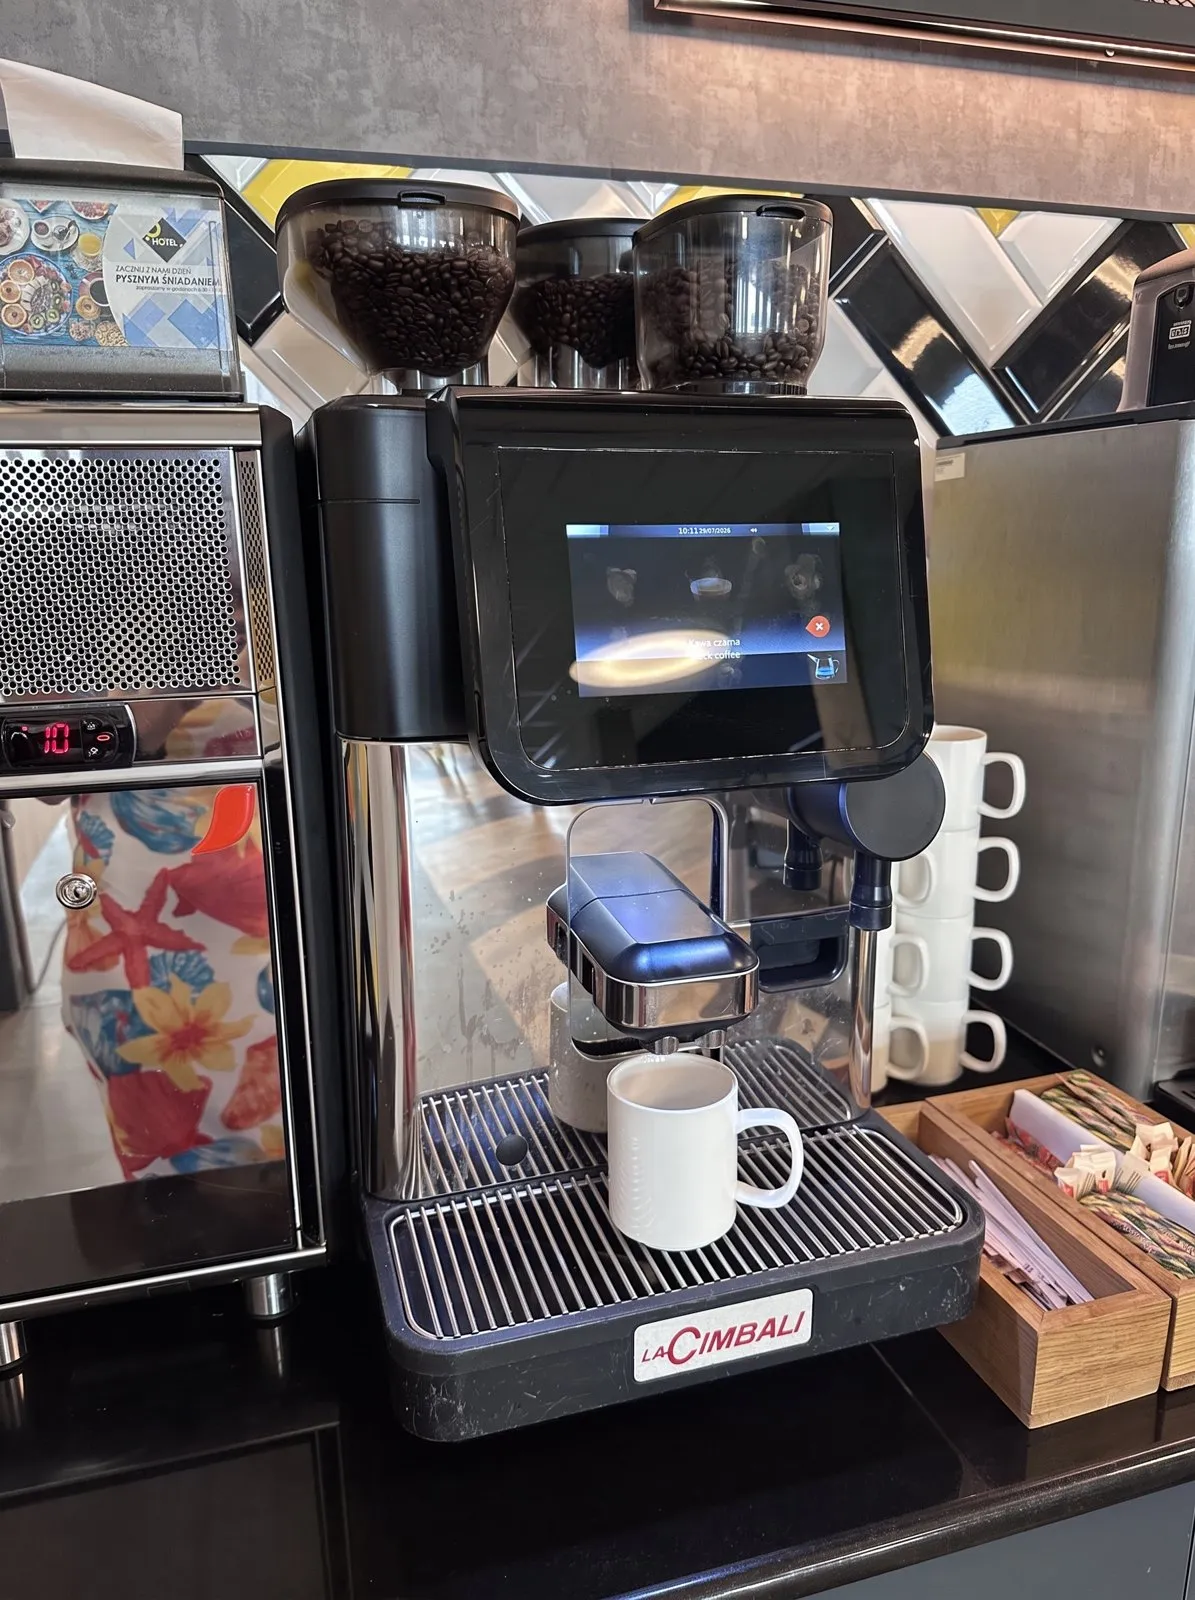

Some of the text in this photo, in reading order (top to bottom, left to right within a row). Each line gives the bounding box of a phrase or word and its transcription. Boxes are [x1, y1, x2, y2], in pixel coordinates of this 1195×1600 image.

[151, 237, 178, 247] HOTEL
[115, 265, 145, 273] ZACZNIJ
[151, 267, 171, 275] NAMI
[172, 267, 192, 275] DZIEŃ
[115, 274, 220, 286] PYSZNYM ŚNIADANIEM
[678, 527, 698, 535] 10:11
[714, 650, 741, 660] coffee
